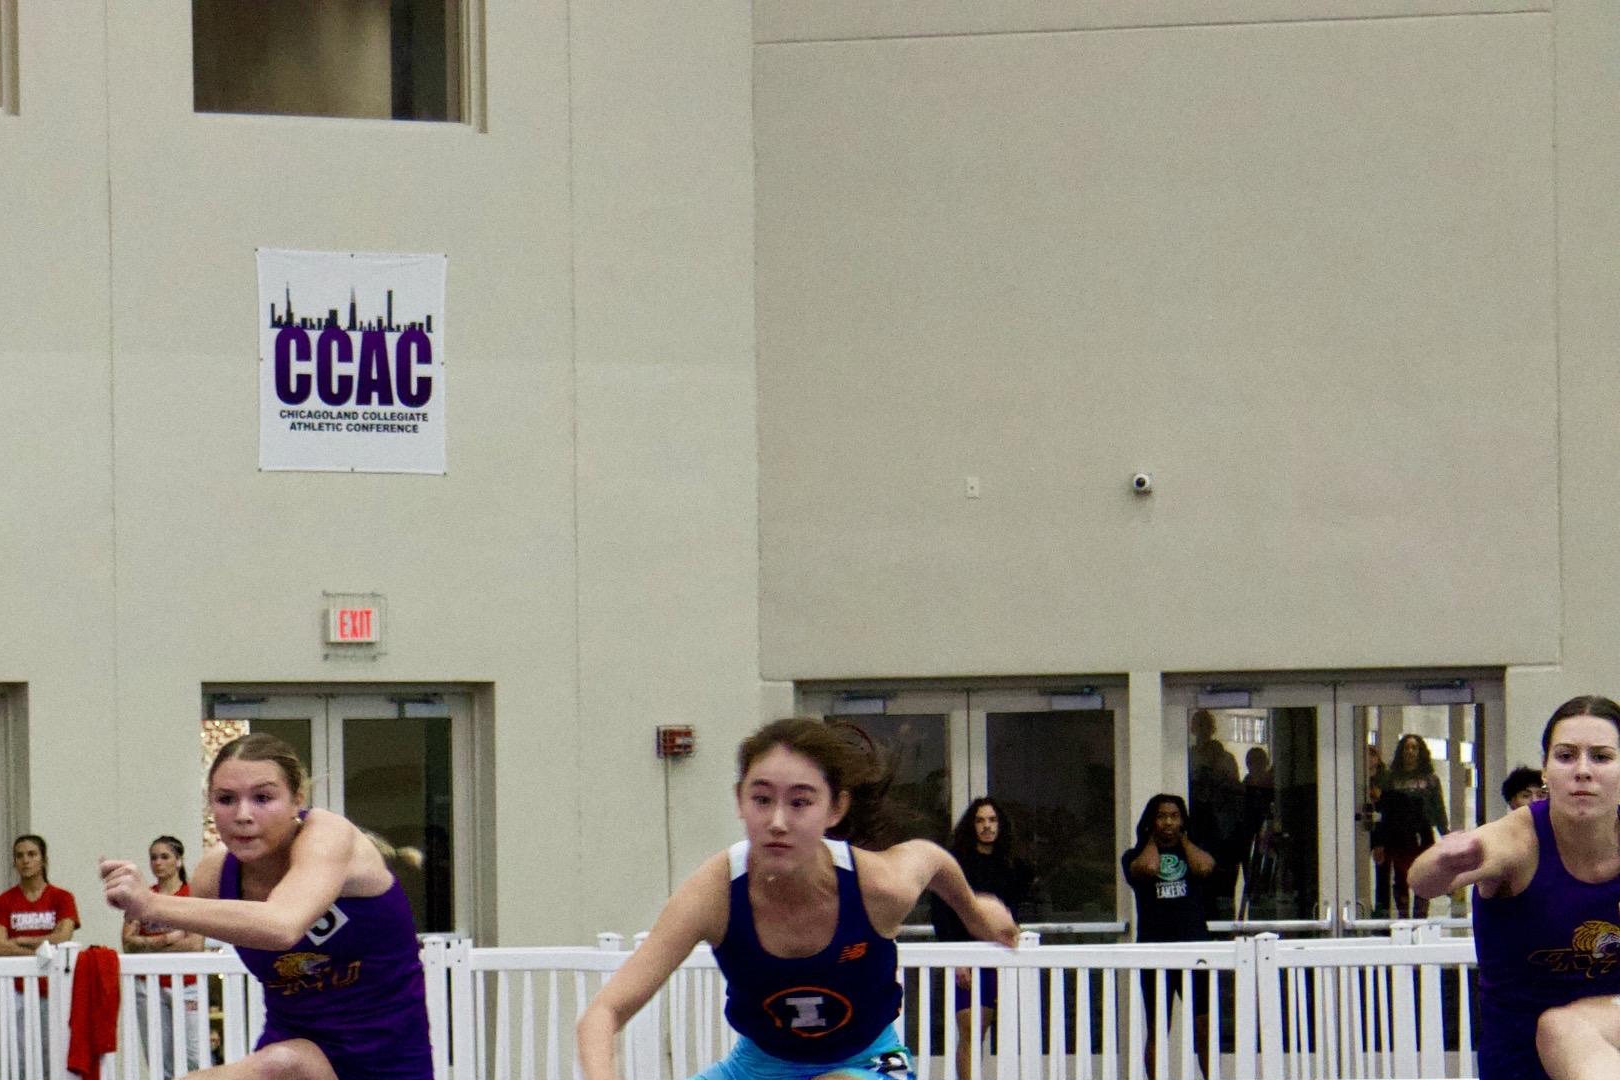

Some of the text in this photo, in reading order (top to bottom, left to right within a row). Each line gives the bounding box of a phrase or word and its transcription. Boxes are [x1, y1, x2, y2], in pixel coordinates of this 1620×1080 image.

[275, 325, 433, 408] CCAC
[279, 409, 429, 422] CHICAGOLAND COLLEGIATE
[289, 422, 419, 433] ATHLETIC CONFERENCE
[339, 607, 372, 640] EXIT
